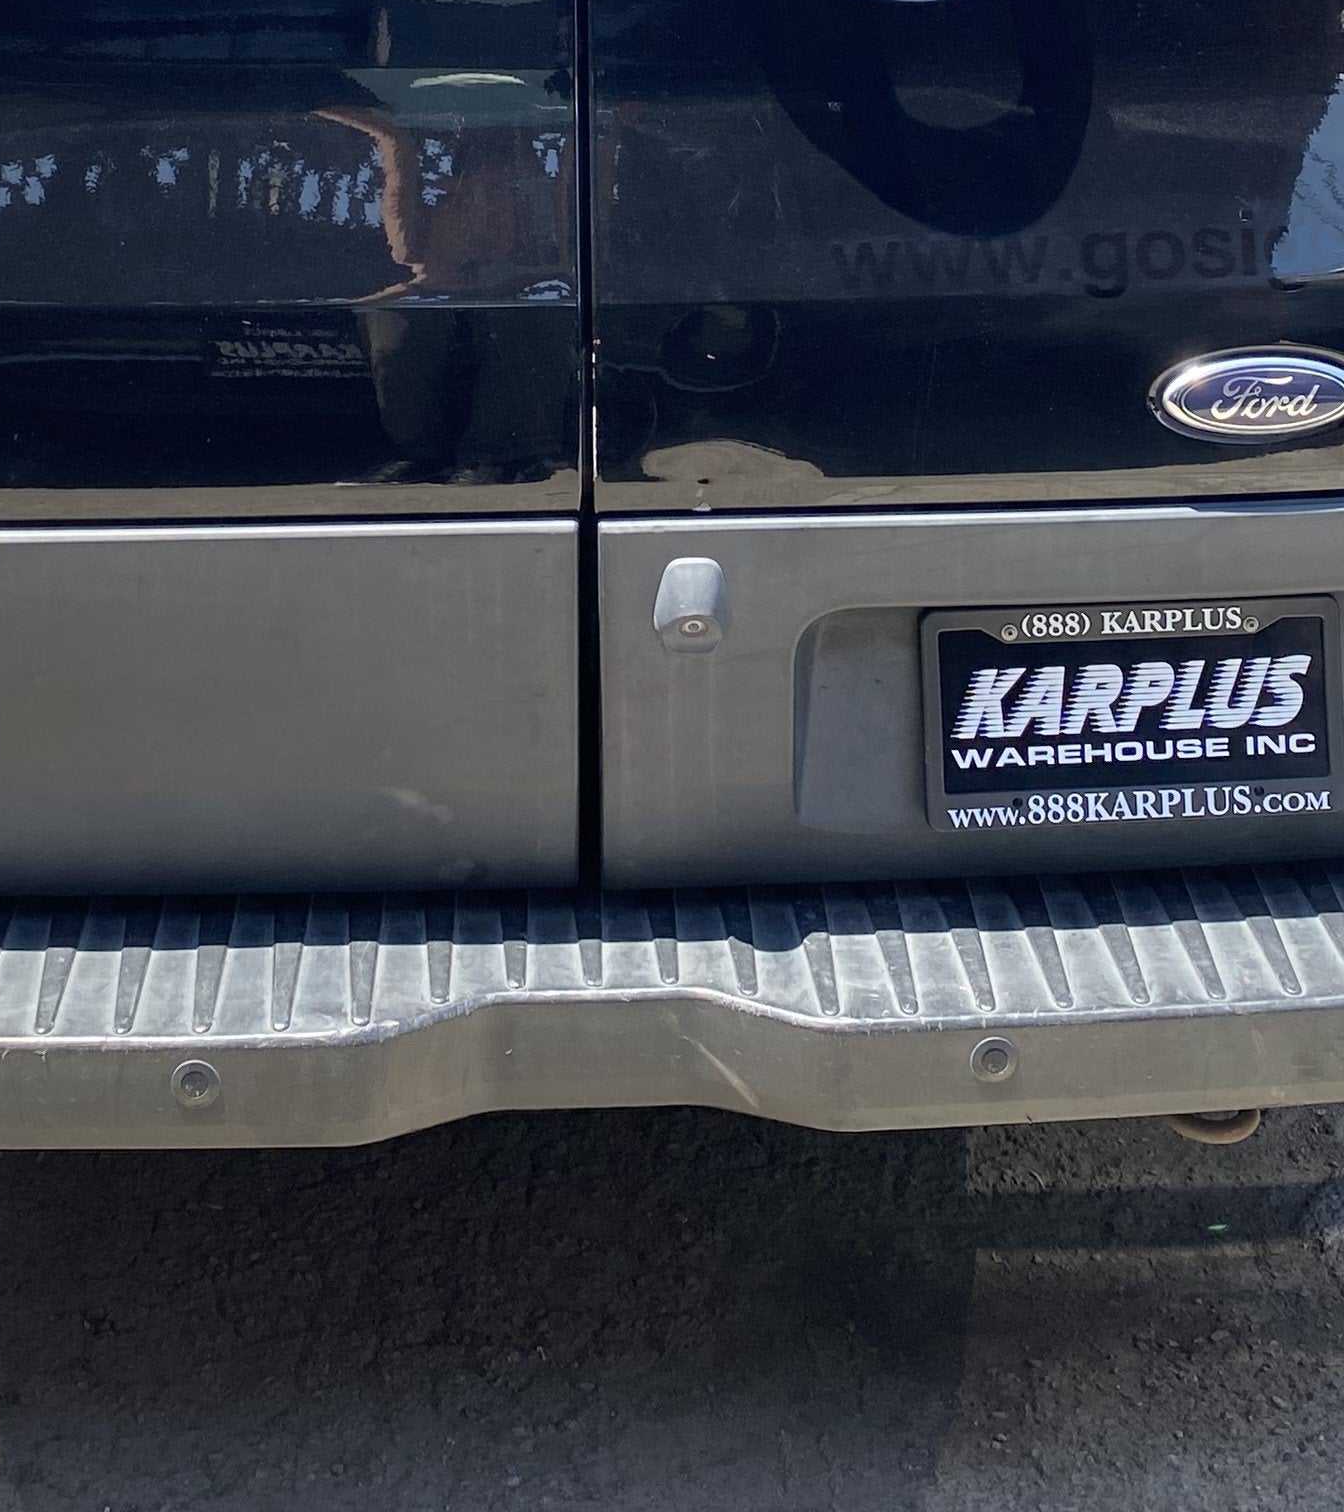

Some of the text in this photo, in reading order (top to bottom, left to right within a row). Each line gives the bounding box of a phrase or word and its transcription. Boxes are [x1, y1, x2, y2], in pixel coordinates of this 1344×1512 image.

[1210, 375, 1320, 420] Ford
[1020, 606, 1242, 639] (888) KARPLUS
[950, 654, 1312, 740] KARPLUS
[951, 732, 1316, 769] WAREHOUSE INC
